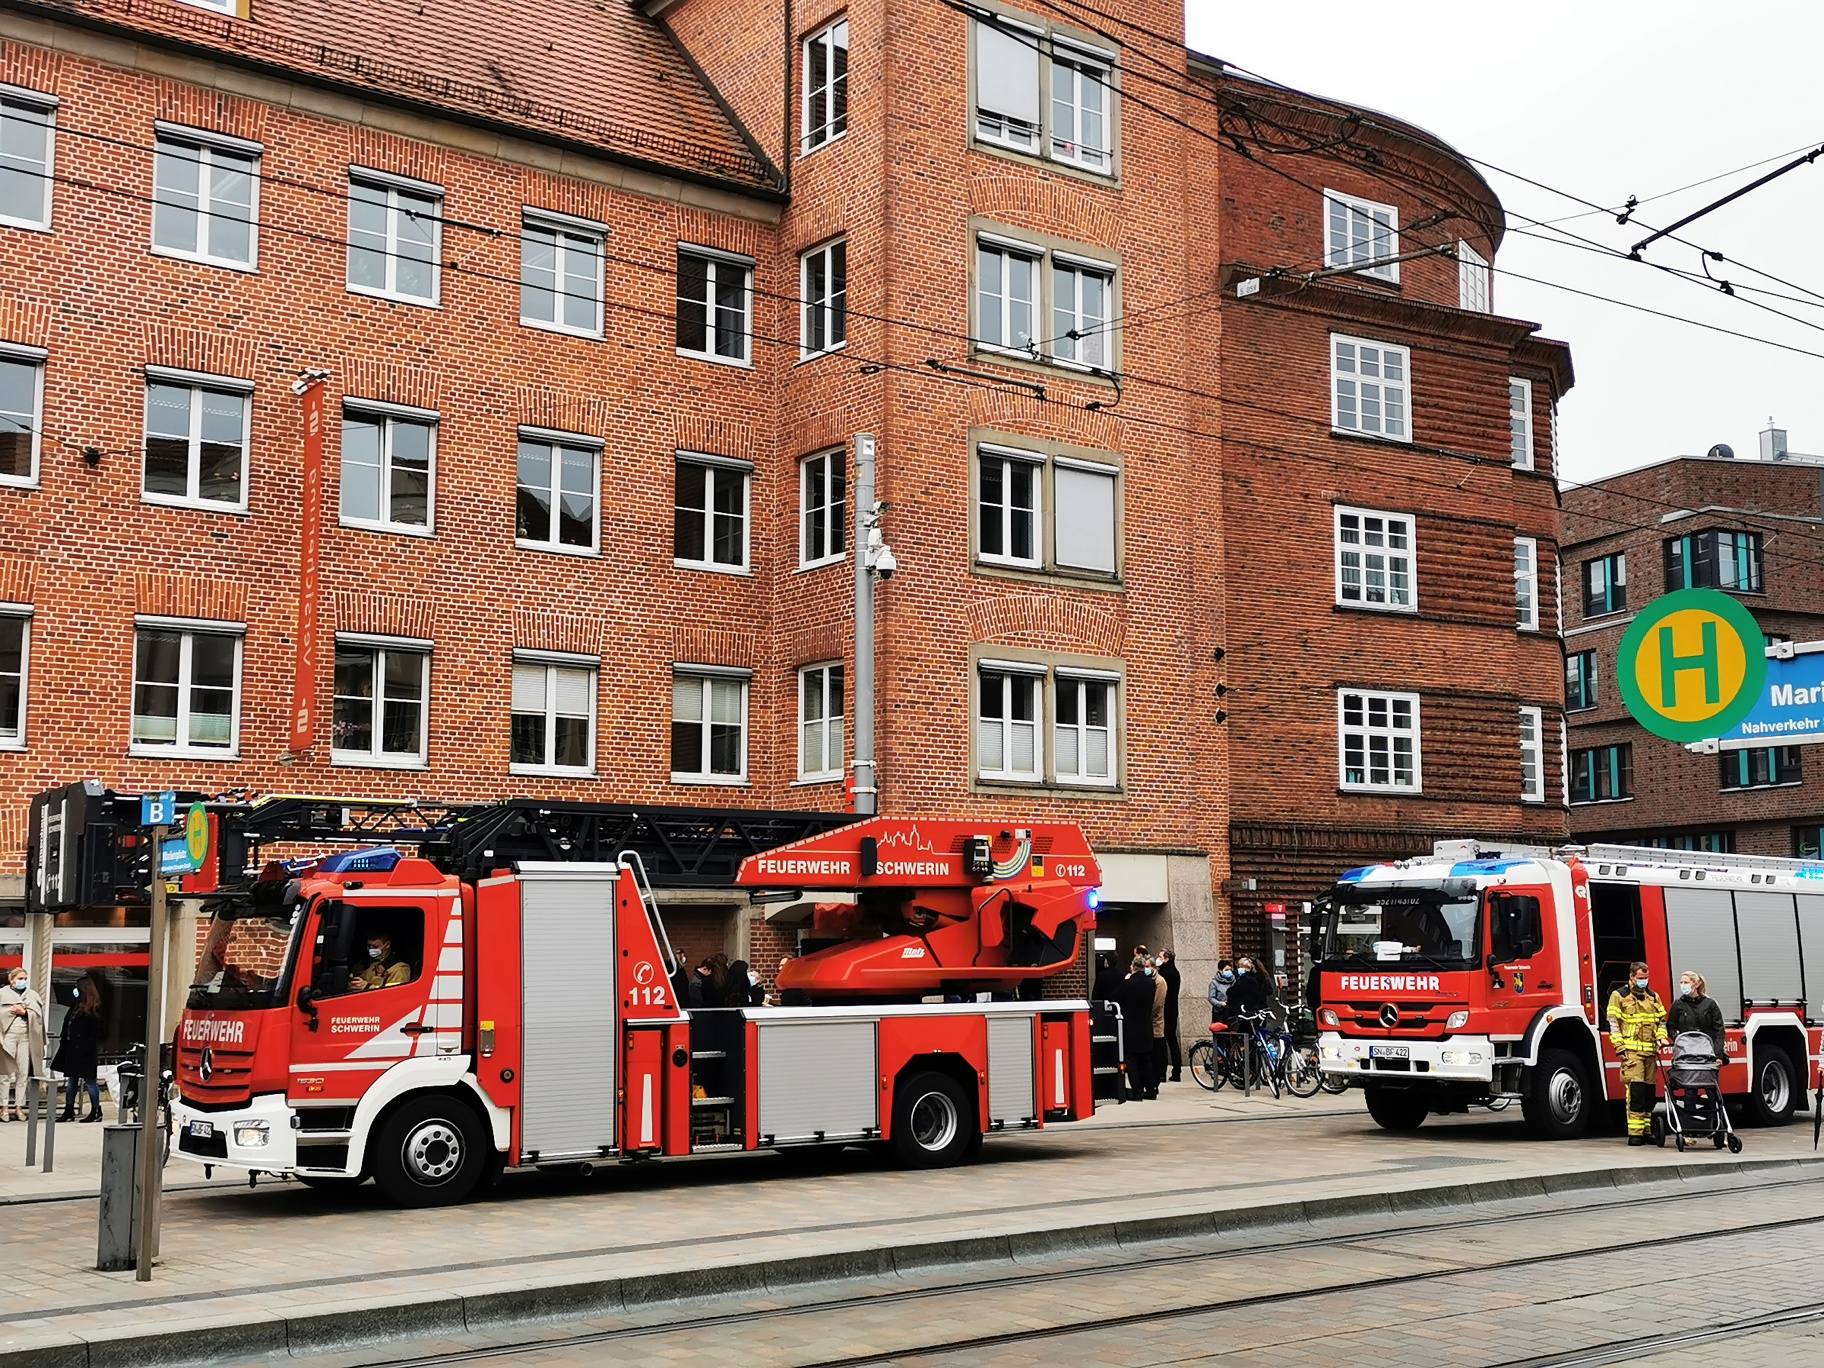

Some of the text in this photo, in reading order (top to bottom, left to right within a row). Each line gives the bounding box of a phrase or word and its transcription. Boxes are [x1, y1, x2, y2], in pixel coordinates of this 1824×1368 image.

[1658, 620, 1720, 708] H
[1742, 717, 1821, 734] Nahverkehr
[149, 802, 164, 823] B
[757, 859, 950, 876] FEUERWEHR SCHWERIN
[1066, 865, 1086, 877] 112
[1341, 975, 1440, 991] FEUERWEHR
[628, 985, 666, 1006] 112
[331, 1016, 380, 1024] FEUERWEHR
[331, 1024, 381, 1033] SCHWERIN
[182, 1019, 245, 1043] FEUERWEHR
[1373, 1047, 1383, 1056] SN
[1395, 1048, 1408, 1057] 422
